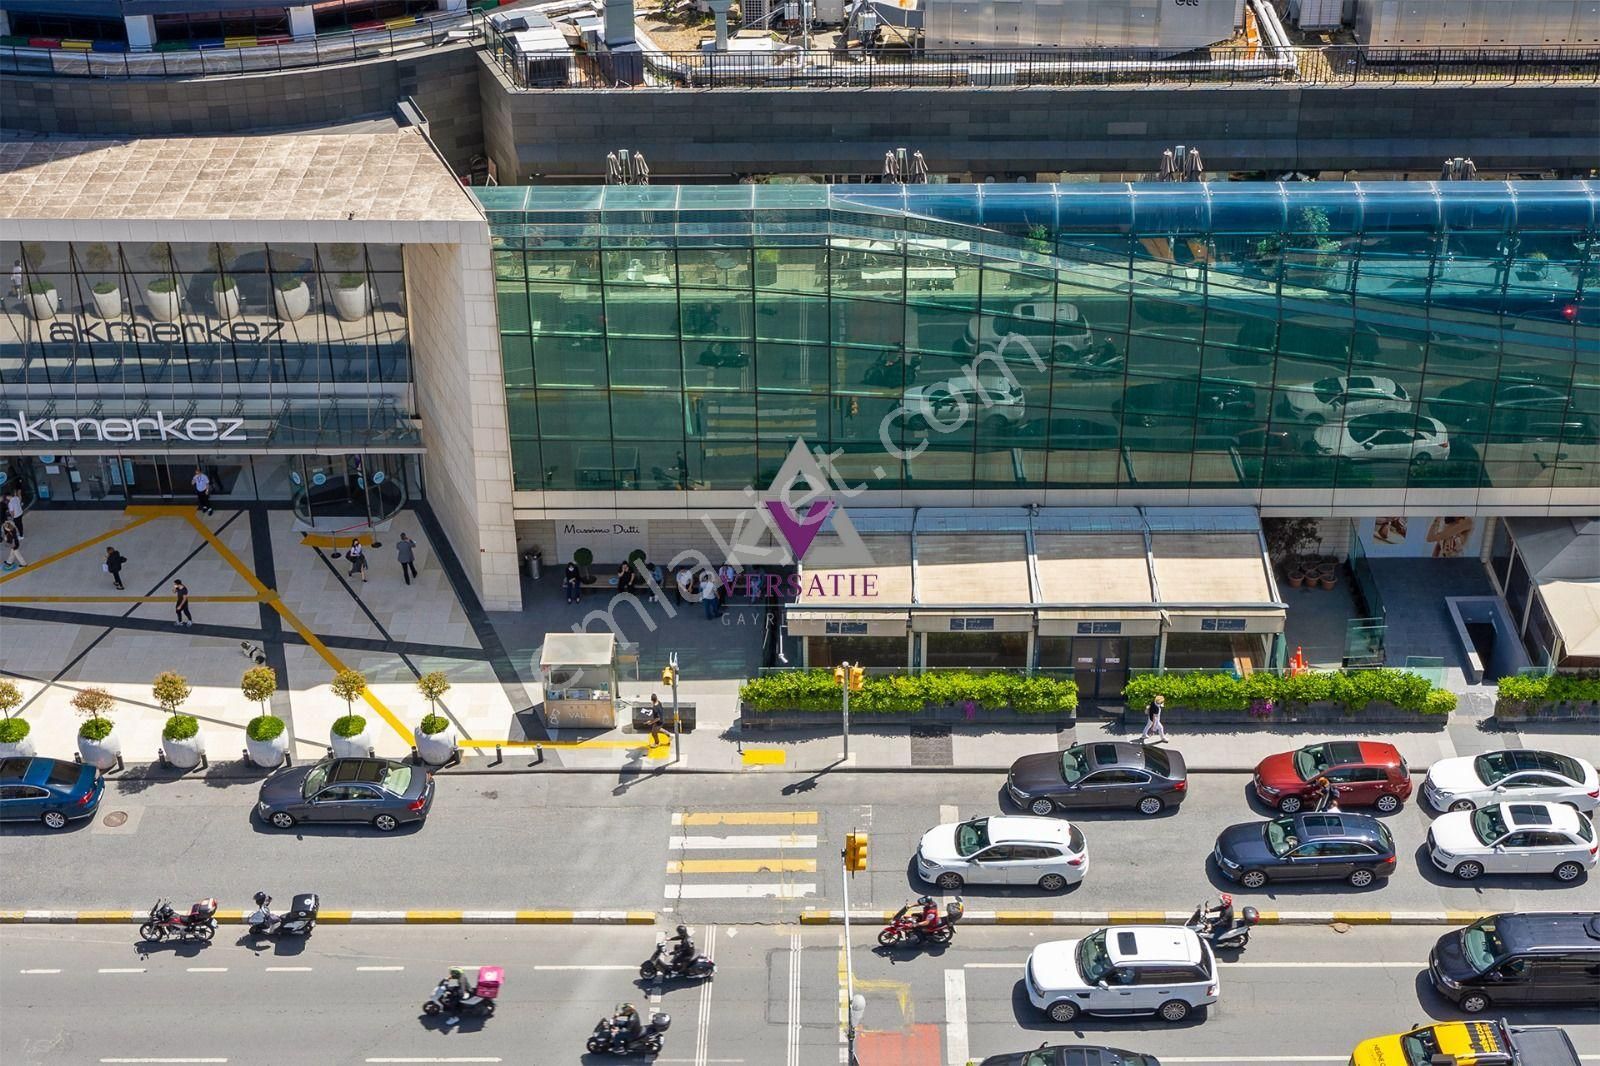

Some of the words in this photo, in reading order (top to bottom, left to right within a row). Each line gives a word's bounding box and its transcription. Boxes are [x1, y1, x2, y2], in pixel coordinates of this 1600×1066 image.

[49, 314, 288, 344] akmerkez
[0, 410, 247, 442] akmerkez
[563, 523, 610, 534] Massimo
[612, 523, 641, 534] Dutti
